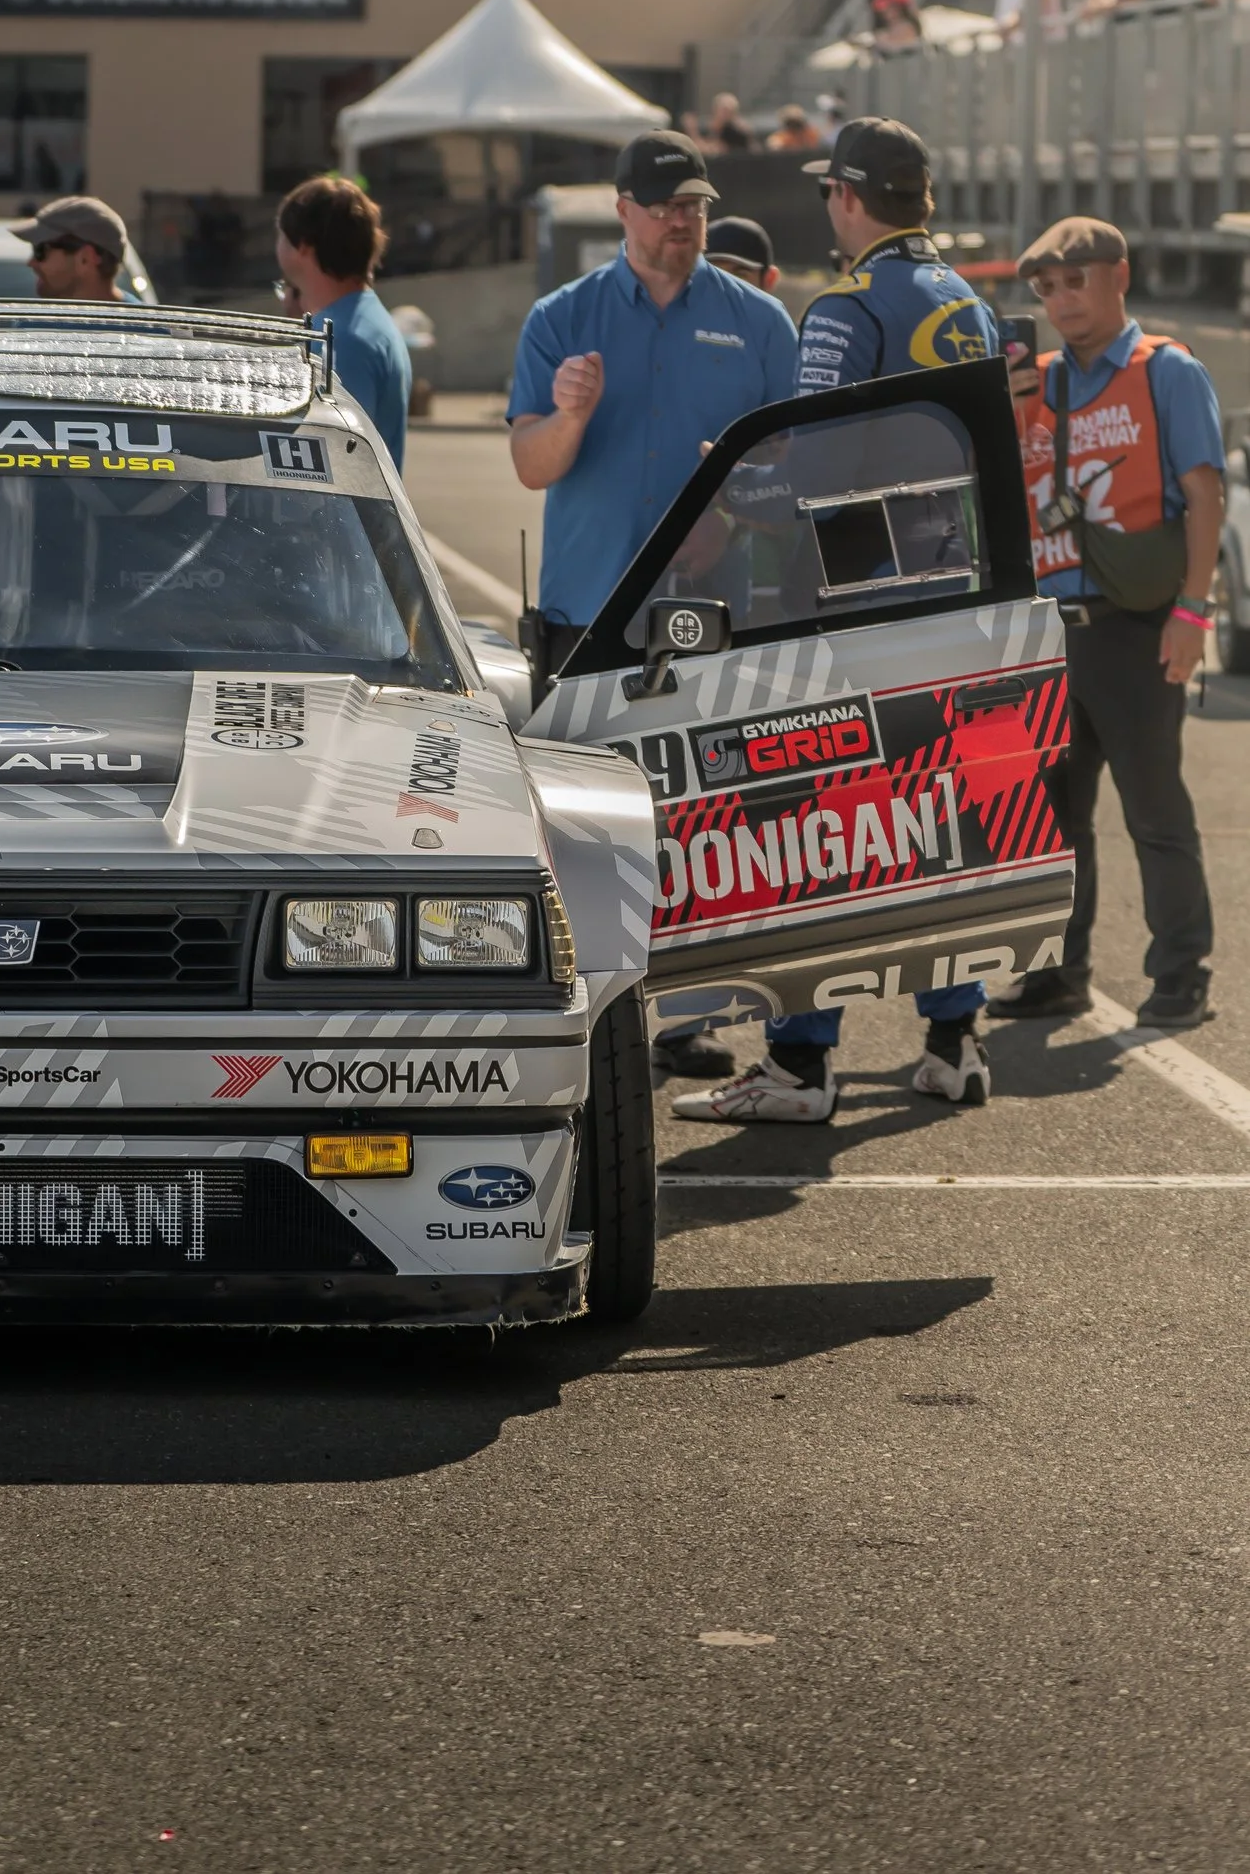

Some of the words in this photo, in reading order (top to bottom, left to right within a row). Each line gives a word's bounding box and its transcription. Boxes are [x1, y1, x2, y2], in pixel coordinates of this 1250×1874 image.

[103, 456, 176, 472] USA
[742, 703, 864, 739] GYMKHANA
[407, 733, 462, 795] YOKOHAMA
[283, 1060, 509, 1093] YOKOHAMA
[426, 1222, 545, 1240] SUBARU
